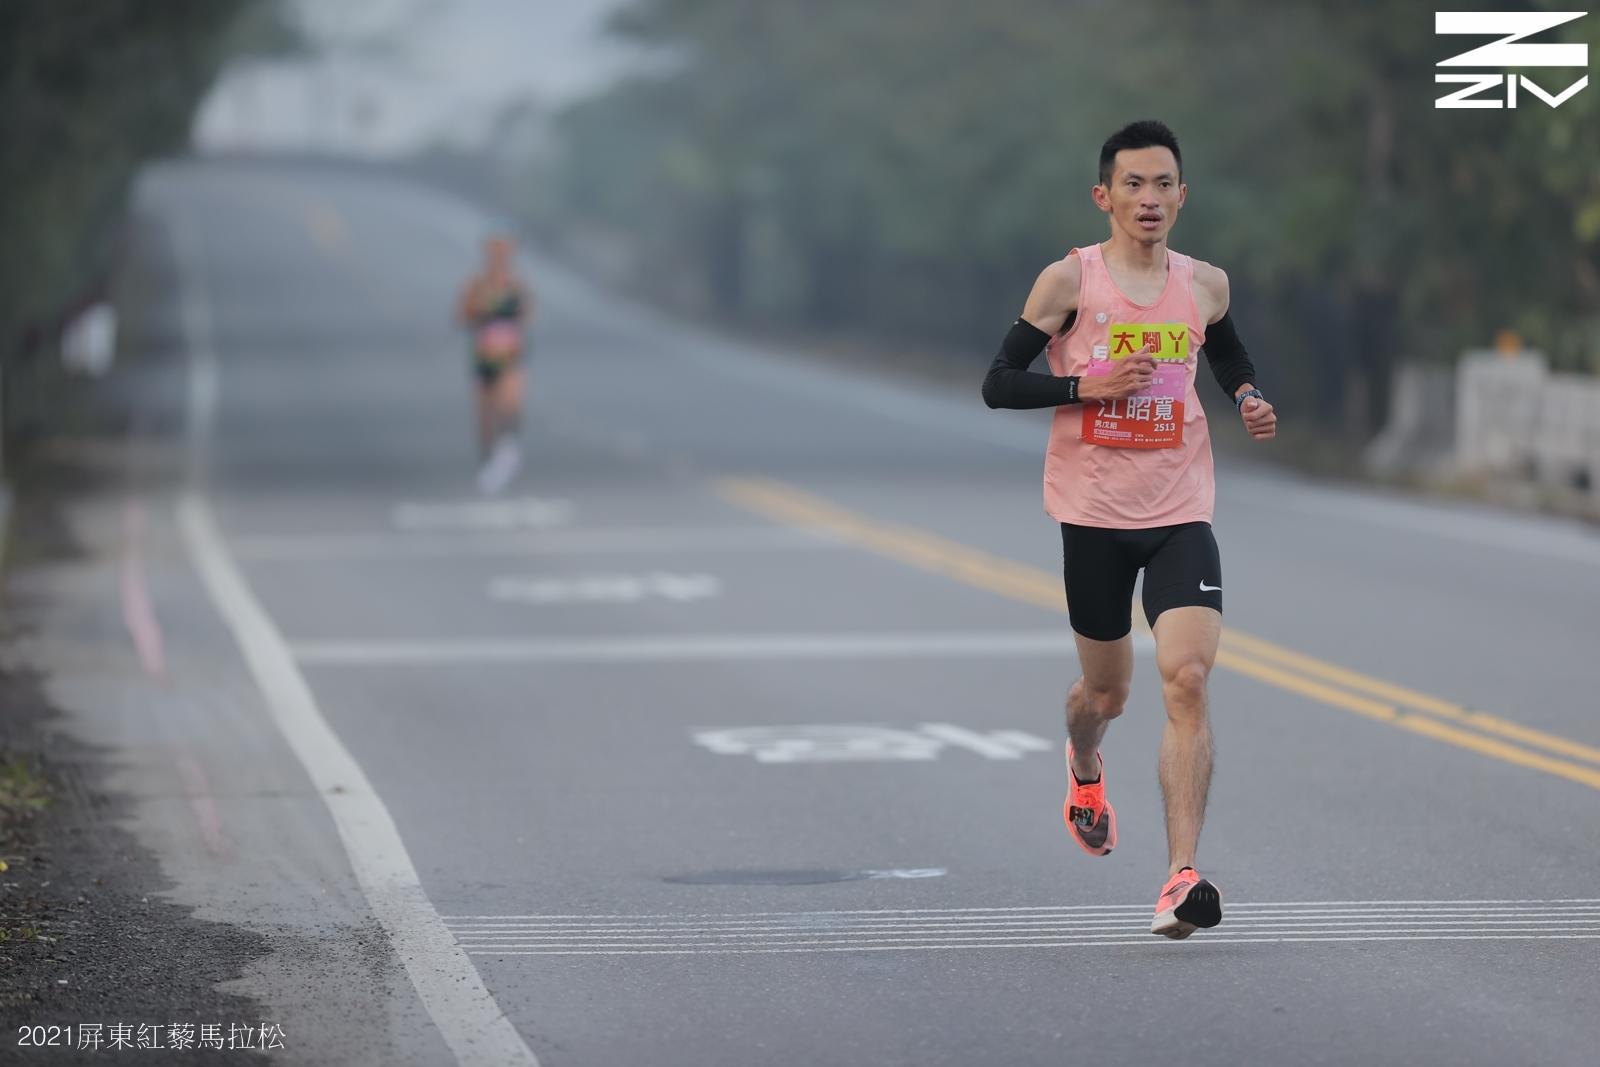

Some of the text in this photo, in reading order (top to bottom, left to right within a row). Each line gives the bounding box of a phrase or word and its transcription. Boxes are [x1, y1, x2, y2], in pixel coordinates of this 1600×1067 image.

[1097, 396, 1175, 421] 江昭寬
[1153, 423, 1176, 432] 2513
